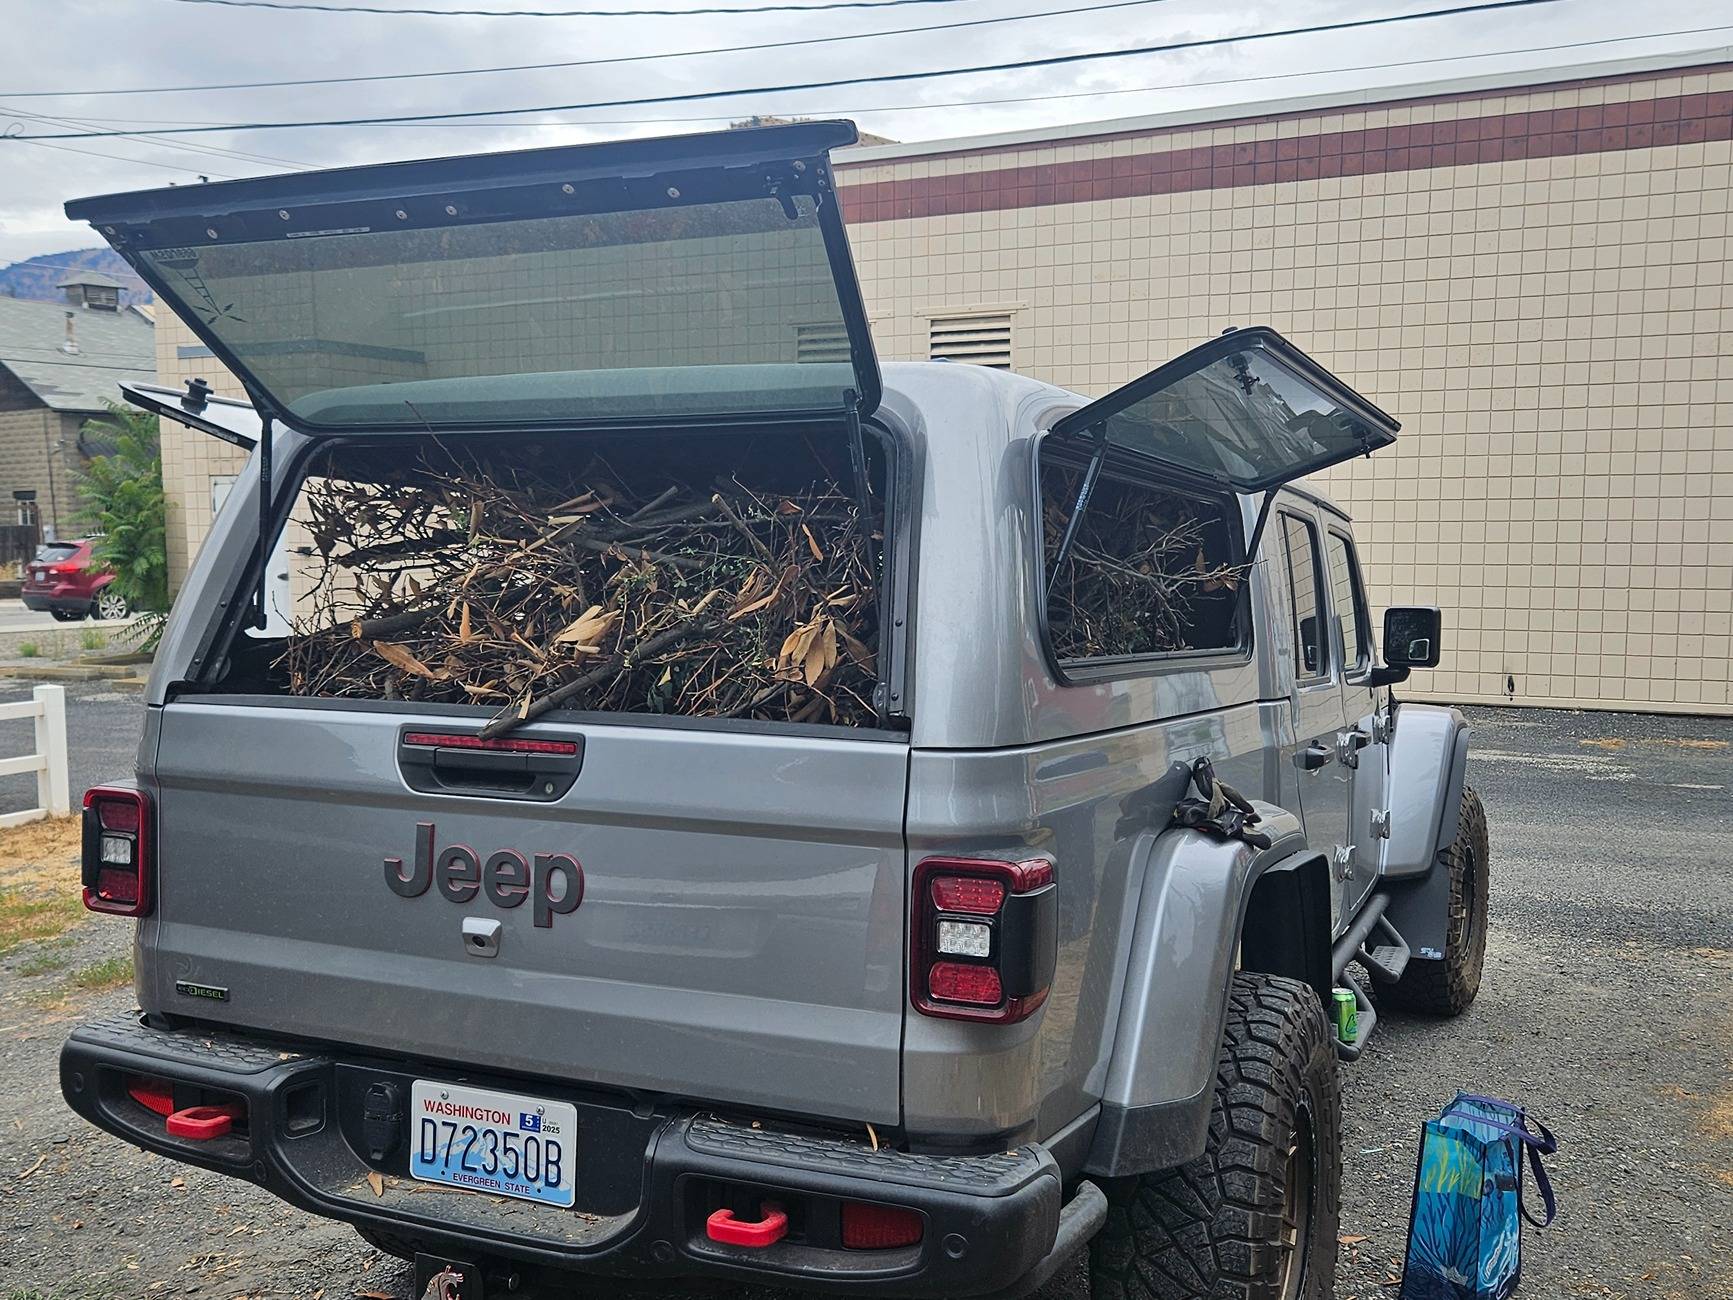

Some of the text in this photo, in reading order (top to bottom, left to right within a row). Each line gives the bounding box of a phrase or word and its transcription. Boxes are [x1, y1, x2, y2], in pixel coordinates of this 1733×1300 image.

[384, 822, 585, 928] Jeep
[424, 1099, 511, 1126] WASHINGTON
[525, 1114, 534, 1127] 5
[542, 1124, 561, 1134] 2025
[420, 1117, 562, 1188] D72350B
[453, 1173, 530, 1195] EVERGREEN STATE
